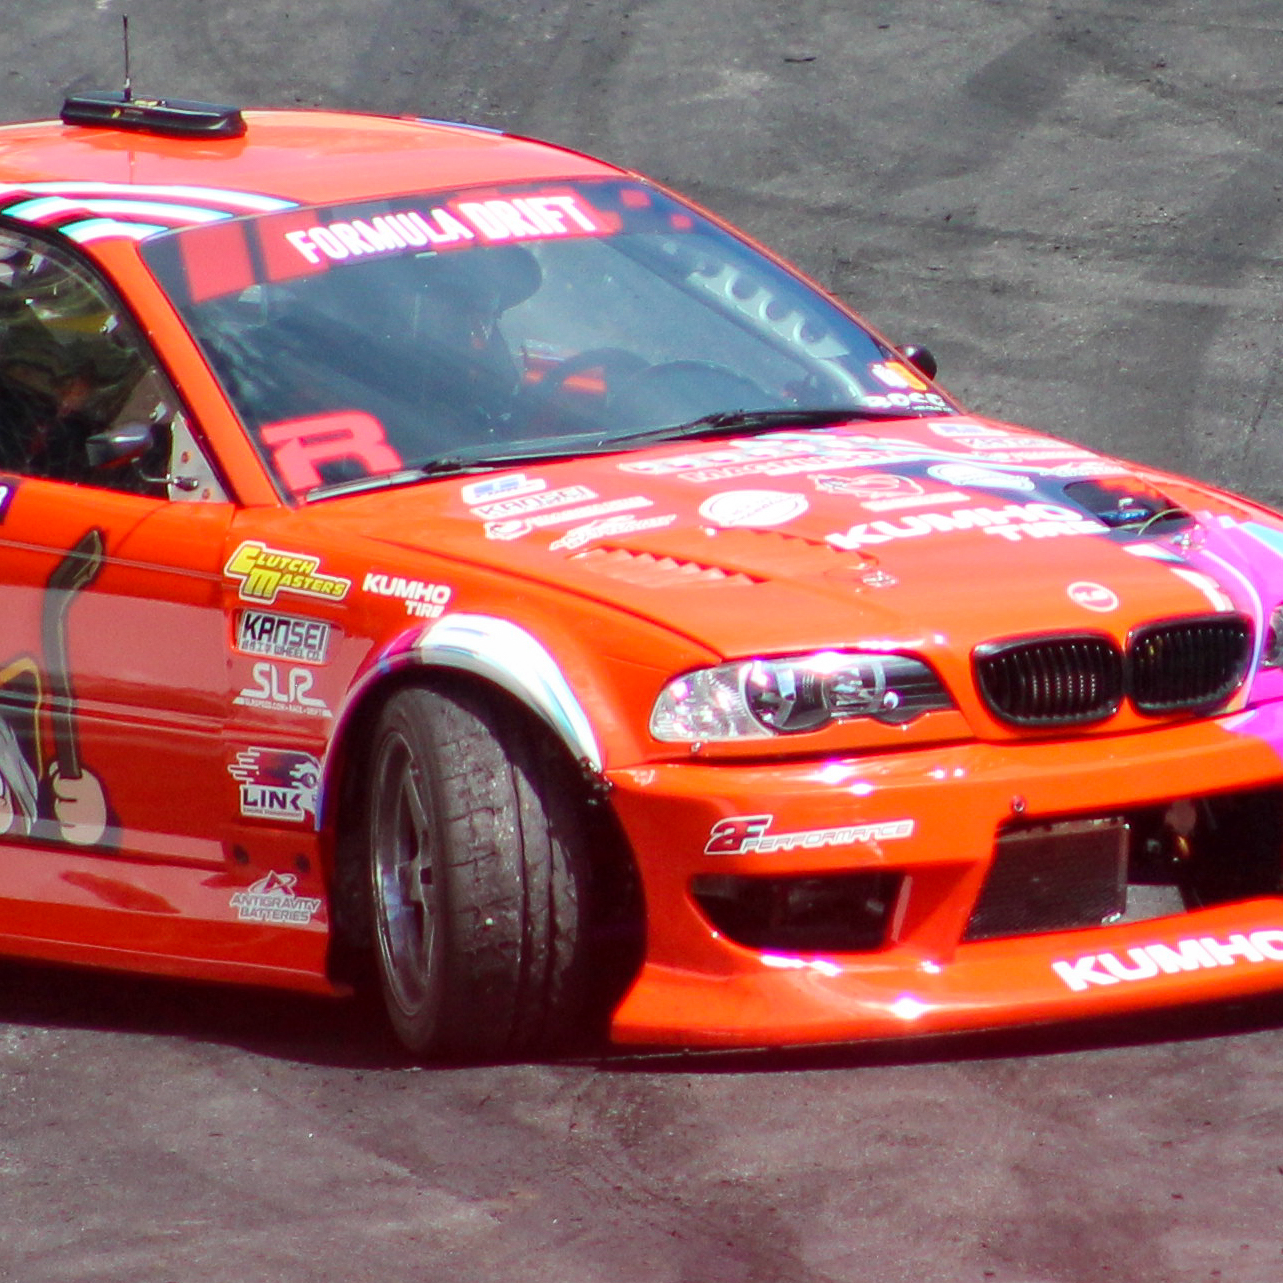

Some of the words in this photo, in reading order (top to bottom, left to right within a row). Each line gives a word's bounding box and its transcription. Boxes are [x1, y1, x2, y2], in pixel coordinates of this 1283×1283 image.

[284, 206, 476, 264] FORMULA
[457, 195, 597, 242] DRIFT
[824, 503, 1084, 550] KUMHO
[983, 520, 1111, 542] TIRE
[229, 545, 317, 575] CLUTCH
[244, 566, 349, 598] MASTERS
[362, 573, 452, 604] KUMHO
[405, 600, 445, 618] TIRE
[243, 612, 329, 649] KANSEI
[240, 662, 328, 708] SLR
[242, 788, 303, 811] LINK
[742, 819, 915, 854] PERFORMANCE
[229, 893, 321, 913] ANTIGRAVITY
[239, 906, 311, 924] BATTERIES
